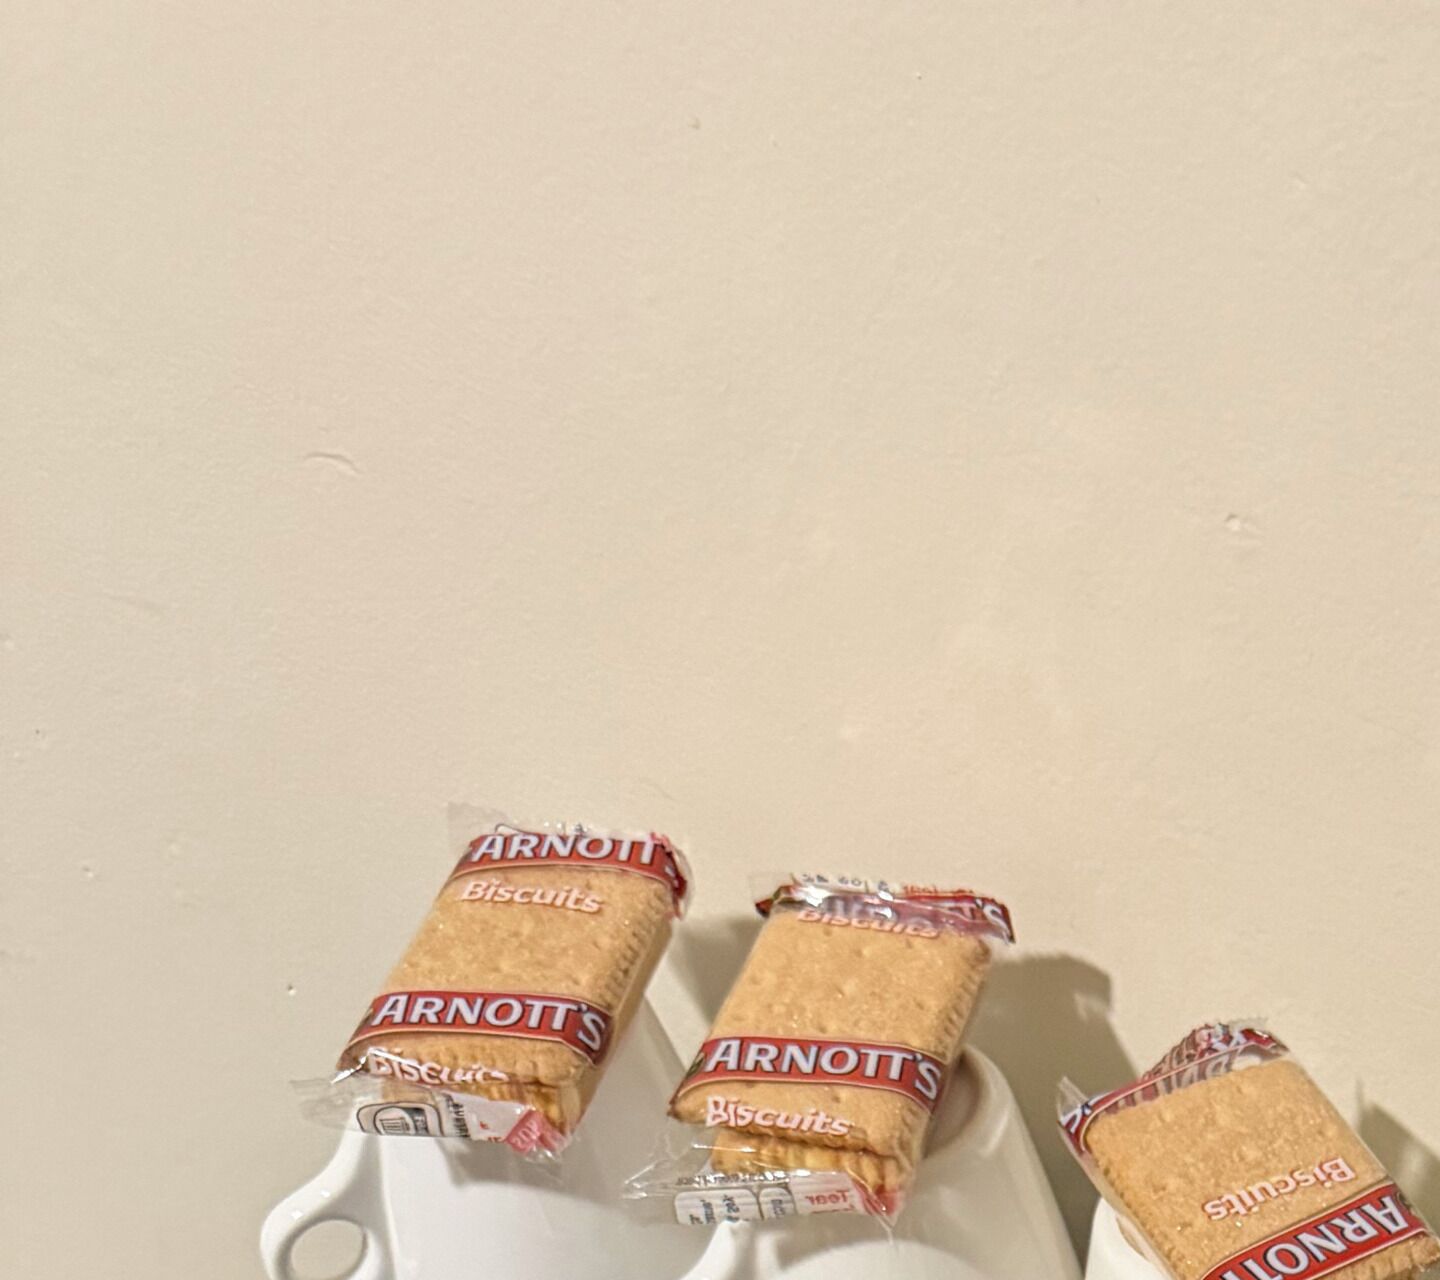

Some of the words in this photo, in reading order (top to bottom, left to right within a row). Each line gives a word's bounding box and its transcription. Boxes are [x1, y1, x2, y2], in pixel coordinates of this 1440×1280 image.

[460, 880, 602, 913] Biscuits
[371, 993, 606, 1052] ARNOTT'S
[704, 1038, 942, 1101] ARNOTT'S
[704, 1096, 852, 1136] Biscuits
[1203, 1156, 1357, 1222] Biscuits
